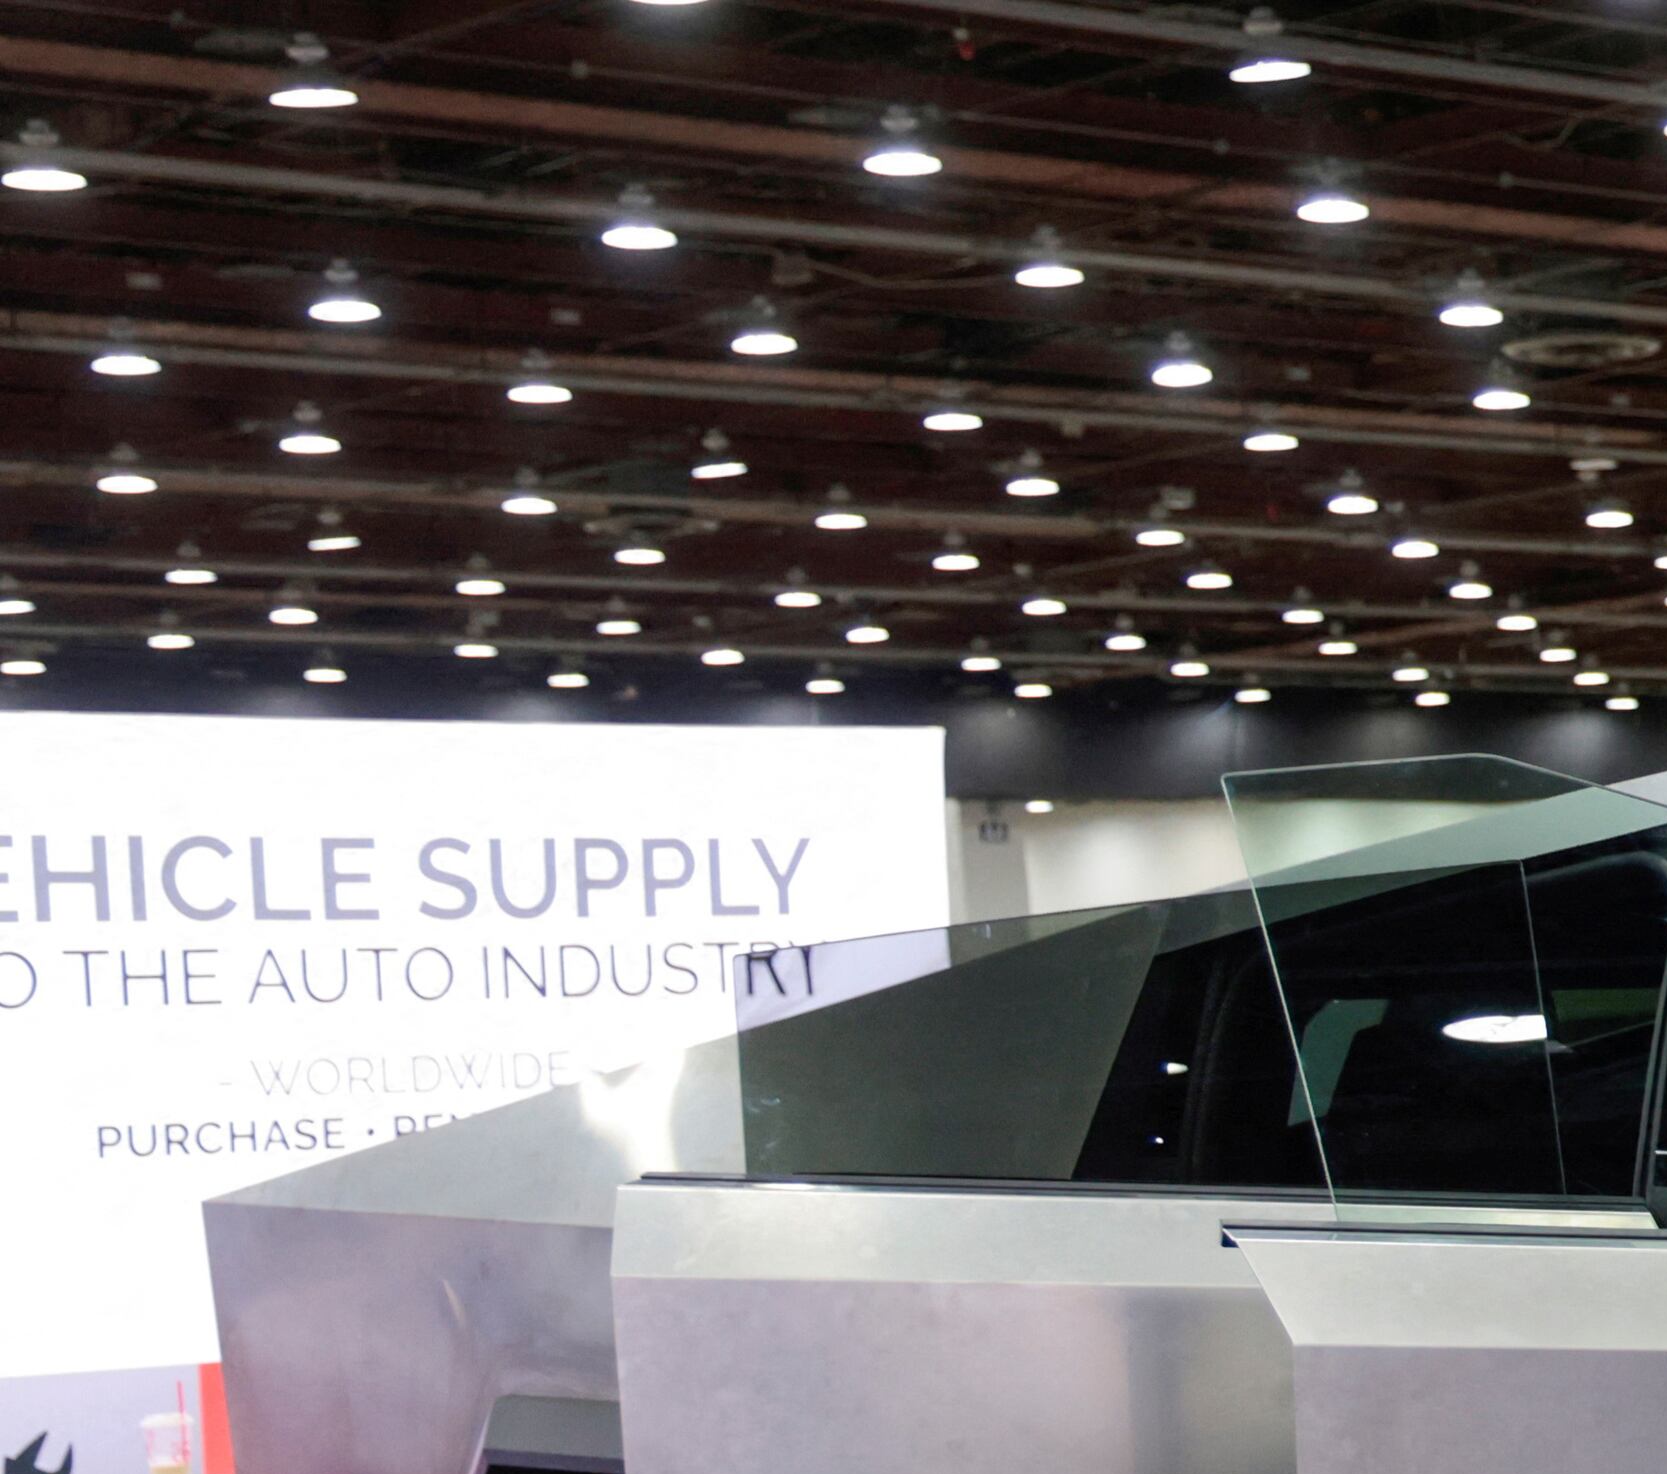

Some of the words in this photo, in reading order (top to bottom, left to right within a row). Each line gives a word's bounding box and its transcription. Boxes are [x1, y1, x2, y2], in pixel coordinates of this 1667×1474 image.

[0, 835, 379, 922] HICLE
[418, 837, 810, 921] SUPPLY
[62, 949, 222, 1007] THE
[249, 947, 454, 1004] AUTO
[483, 940, 826, 1000] INDUSTRY
[250, 1051, 569, 1096] WORLDWIDE
[97, 1117, 346, 1157] PURCHASE
